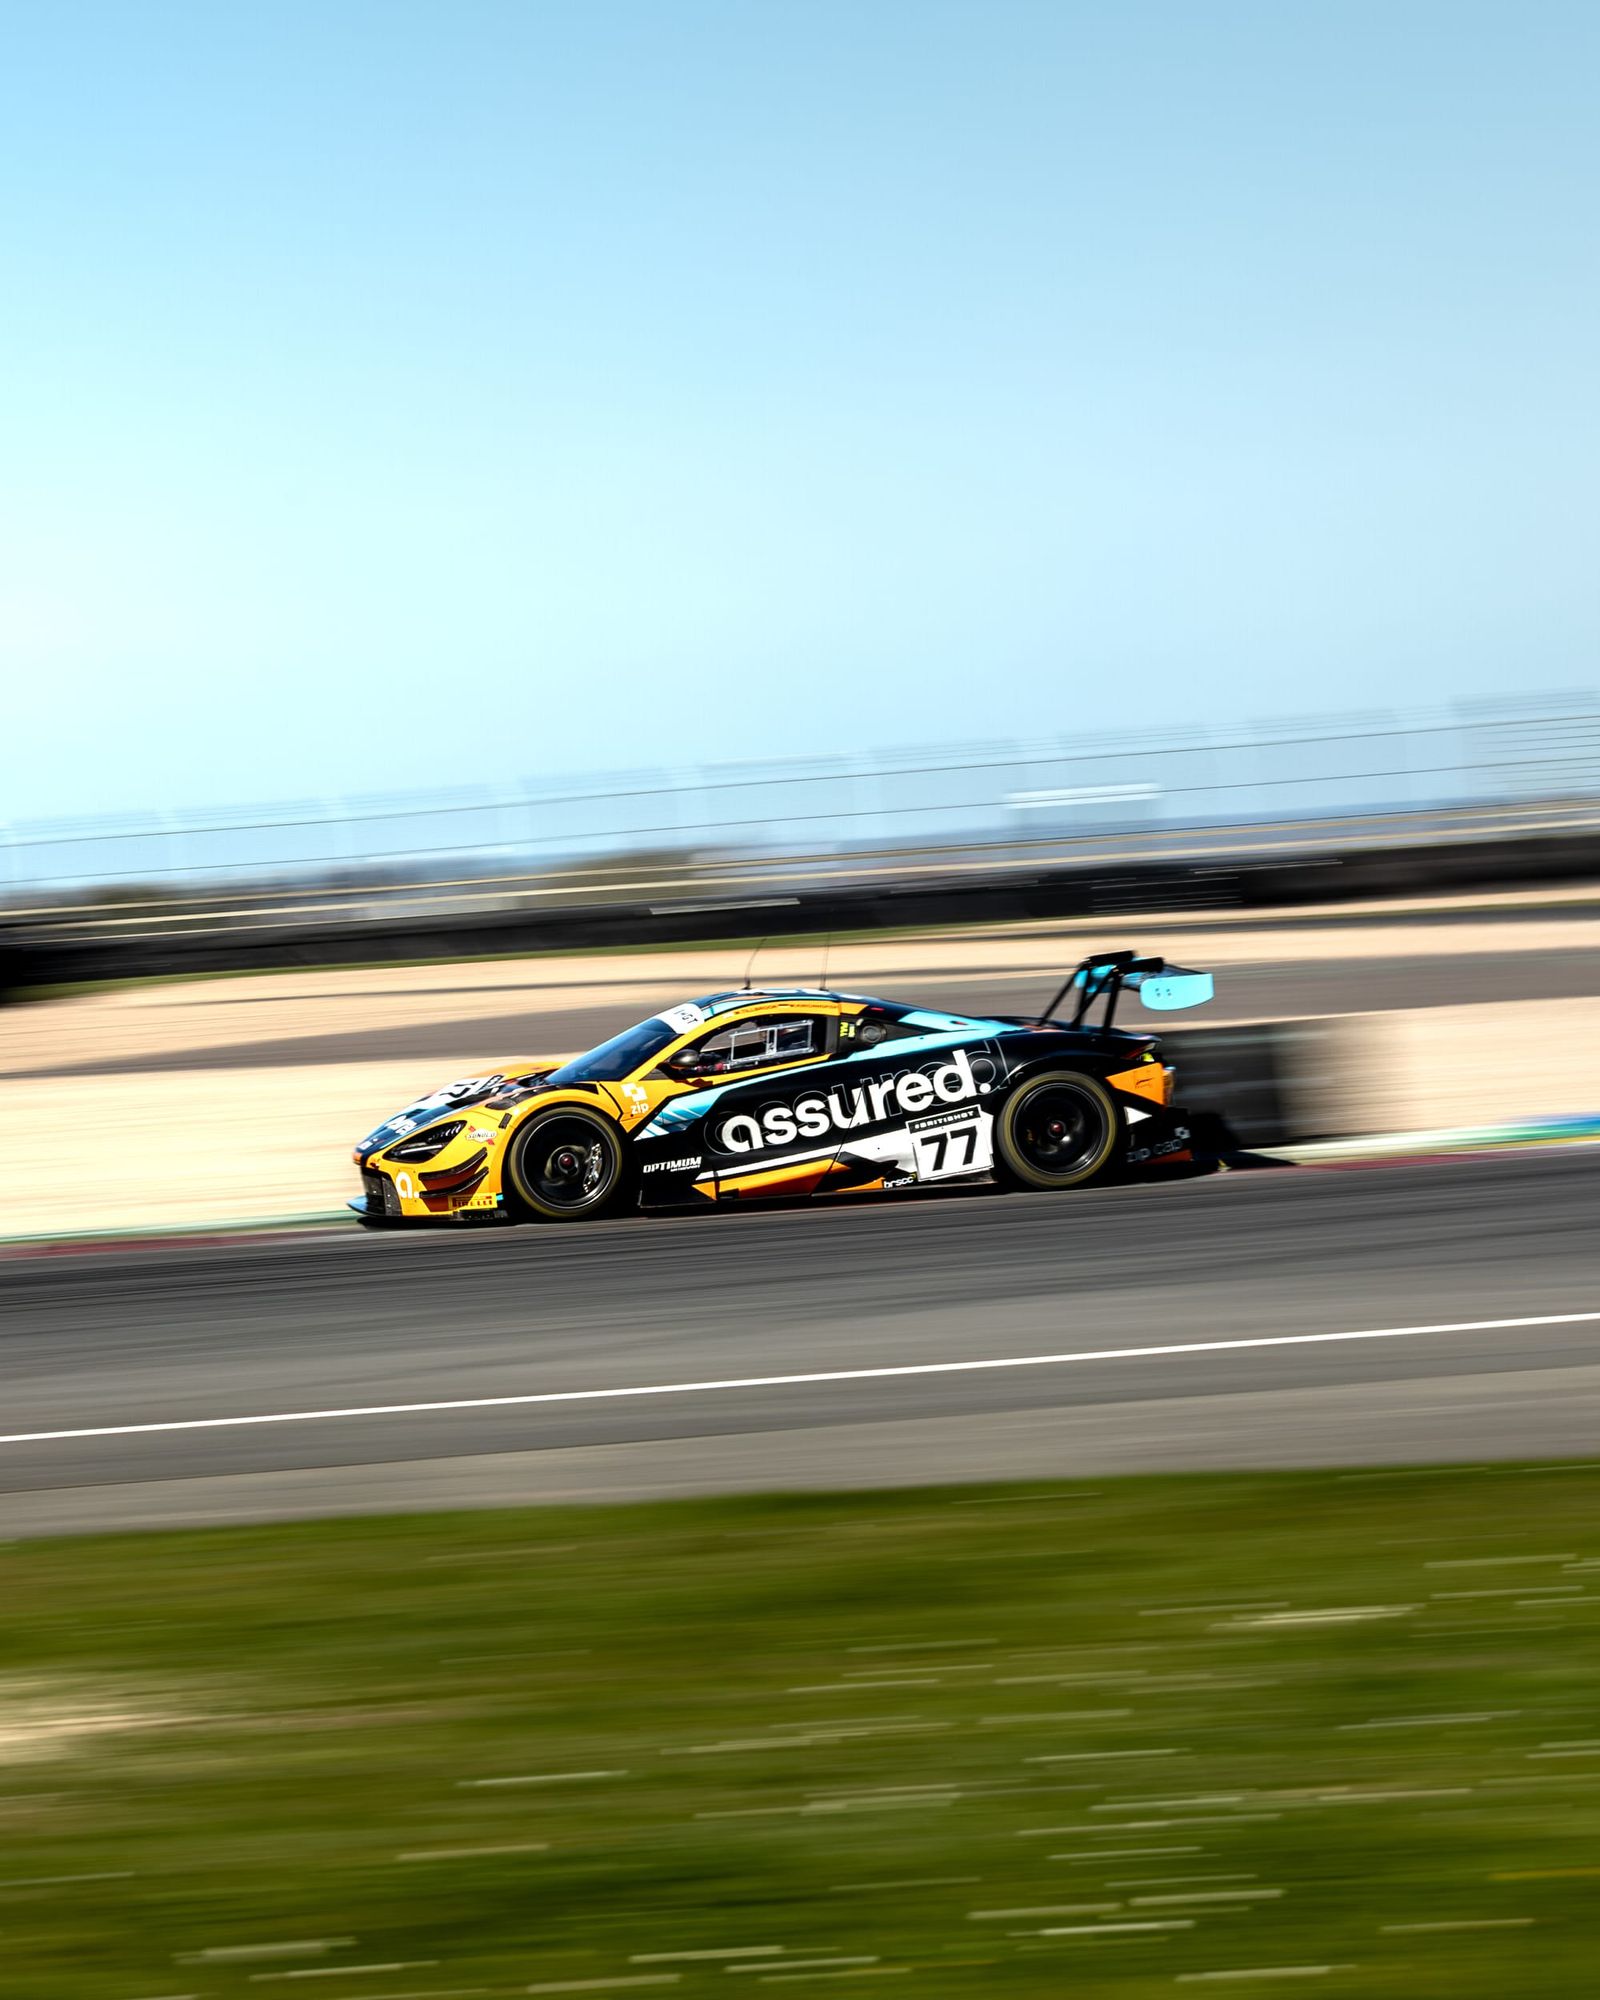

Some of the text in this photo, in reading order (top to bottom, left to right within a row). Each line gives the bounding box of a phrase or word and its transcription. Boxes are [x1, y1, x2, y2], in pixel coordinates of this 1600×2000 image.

[630, 1101, 649, 1115] zip
[920, 1125, 978, 1172] 77
[642, 1156, 702, 1174] OPTIMUM
